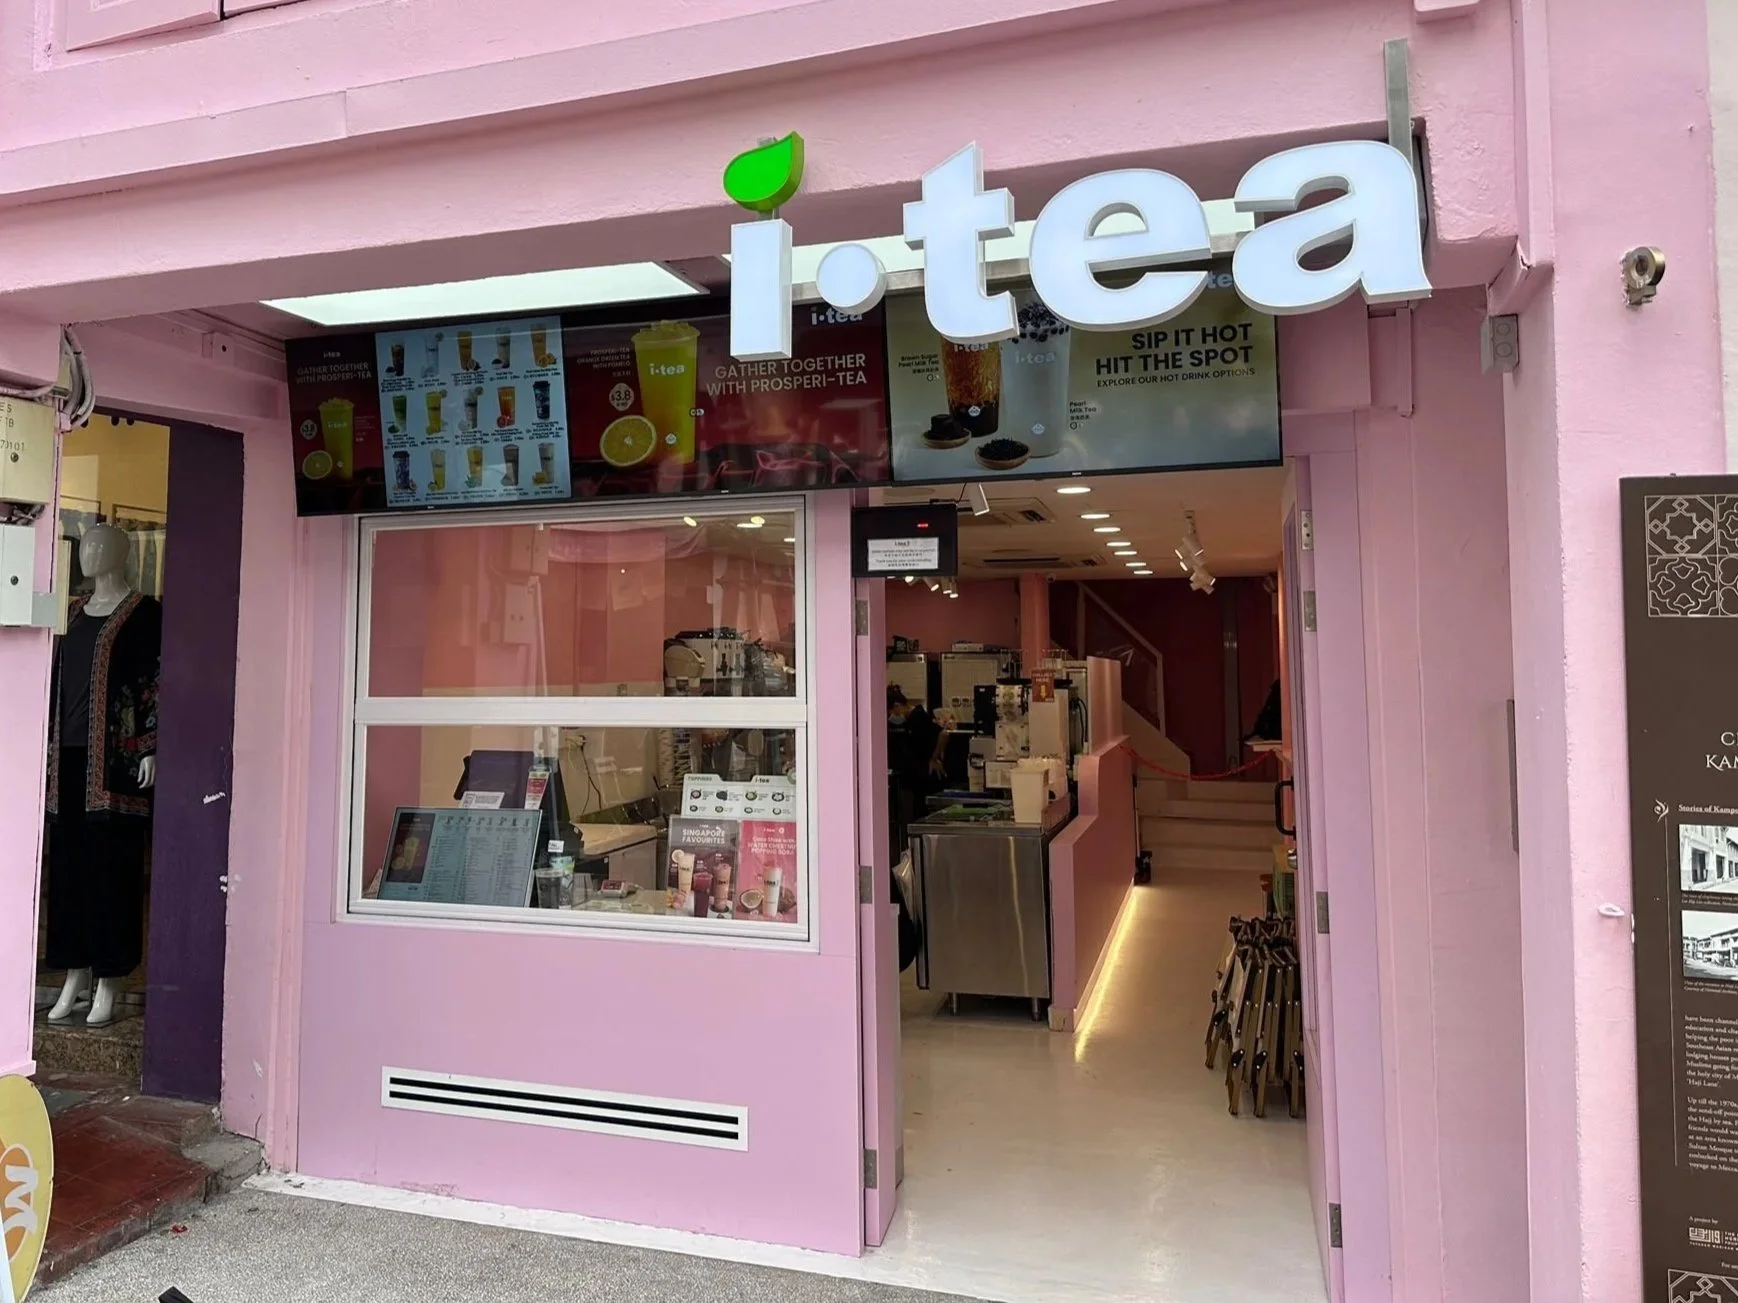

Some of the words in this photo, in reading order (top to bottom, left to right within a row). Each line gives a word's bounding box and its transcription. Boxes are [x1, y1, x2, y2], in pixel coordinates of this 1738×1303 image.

[1132, 330, 1166, 351] SIP
[1174, 329, 1198, 348] IT
[1201, 323, 1253, 344] HOT
[1096, 353, 1131, 376] HIT
[1136, 350, 1183, 371] THE
[1190, 345, 1254, 368] SPOT
[715, 360, 777, 380] GATHER
[782, 353, 866, 374] TOGETHER
[1097, 376, 1136, 388] EXPLORE
[1138, 375, 1158, 385] OUR
[1160, 373, 1180, 383] HOT
[1181, 371, 1211, 382] DRINK
[1213, 367, 1256, 379] OPTIONS
[706, 378, 747, 398] WITH
[750, 370, 868, 393] PROSPERI-TEA
[1069, 400, 1087, 408] Pearl
[1678, 803, 1703, 812] Stories
[1704, 804, 1713, 812] of
[682, 828, 725, 838] SINGAPORE
[682, 836, 725, 845] FAVOURITES
[1685, 1033, 1708, 1042] helping
[1685, 1051, 1709, 1061] lodging
[1686, 1060, 1712, 1068] Muslims
[1712, 1063, 1730, 1072] going
[1697, 1070, 1710, 1079] holy
[1711, 1072, 1723, 1080] city
[1723, 1072, 1731, 1080] of
[1687, 1096, 1697, 1105] Up
[1713, 1117, 1721, 1125] by
[1688, 1123, 1709, 1132] friends
[1709, 1127, 1729, 1135] would
[1688, 1142, 1708, 1150] Sultan
[1708, 1144, 1733, 1154] Mosque
[1688, 1162, 1709, 1170] voyage
[1711, 1217, 1719, 1225] by
